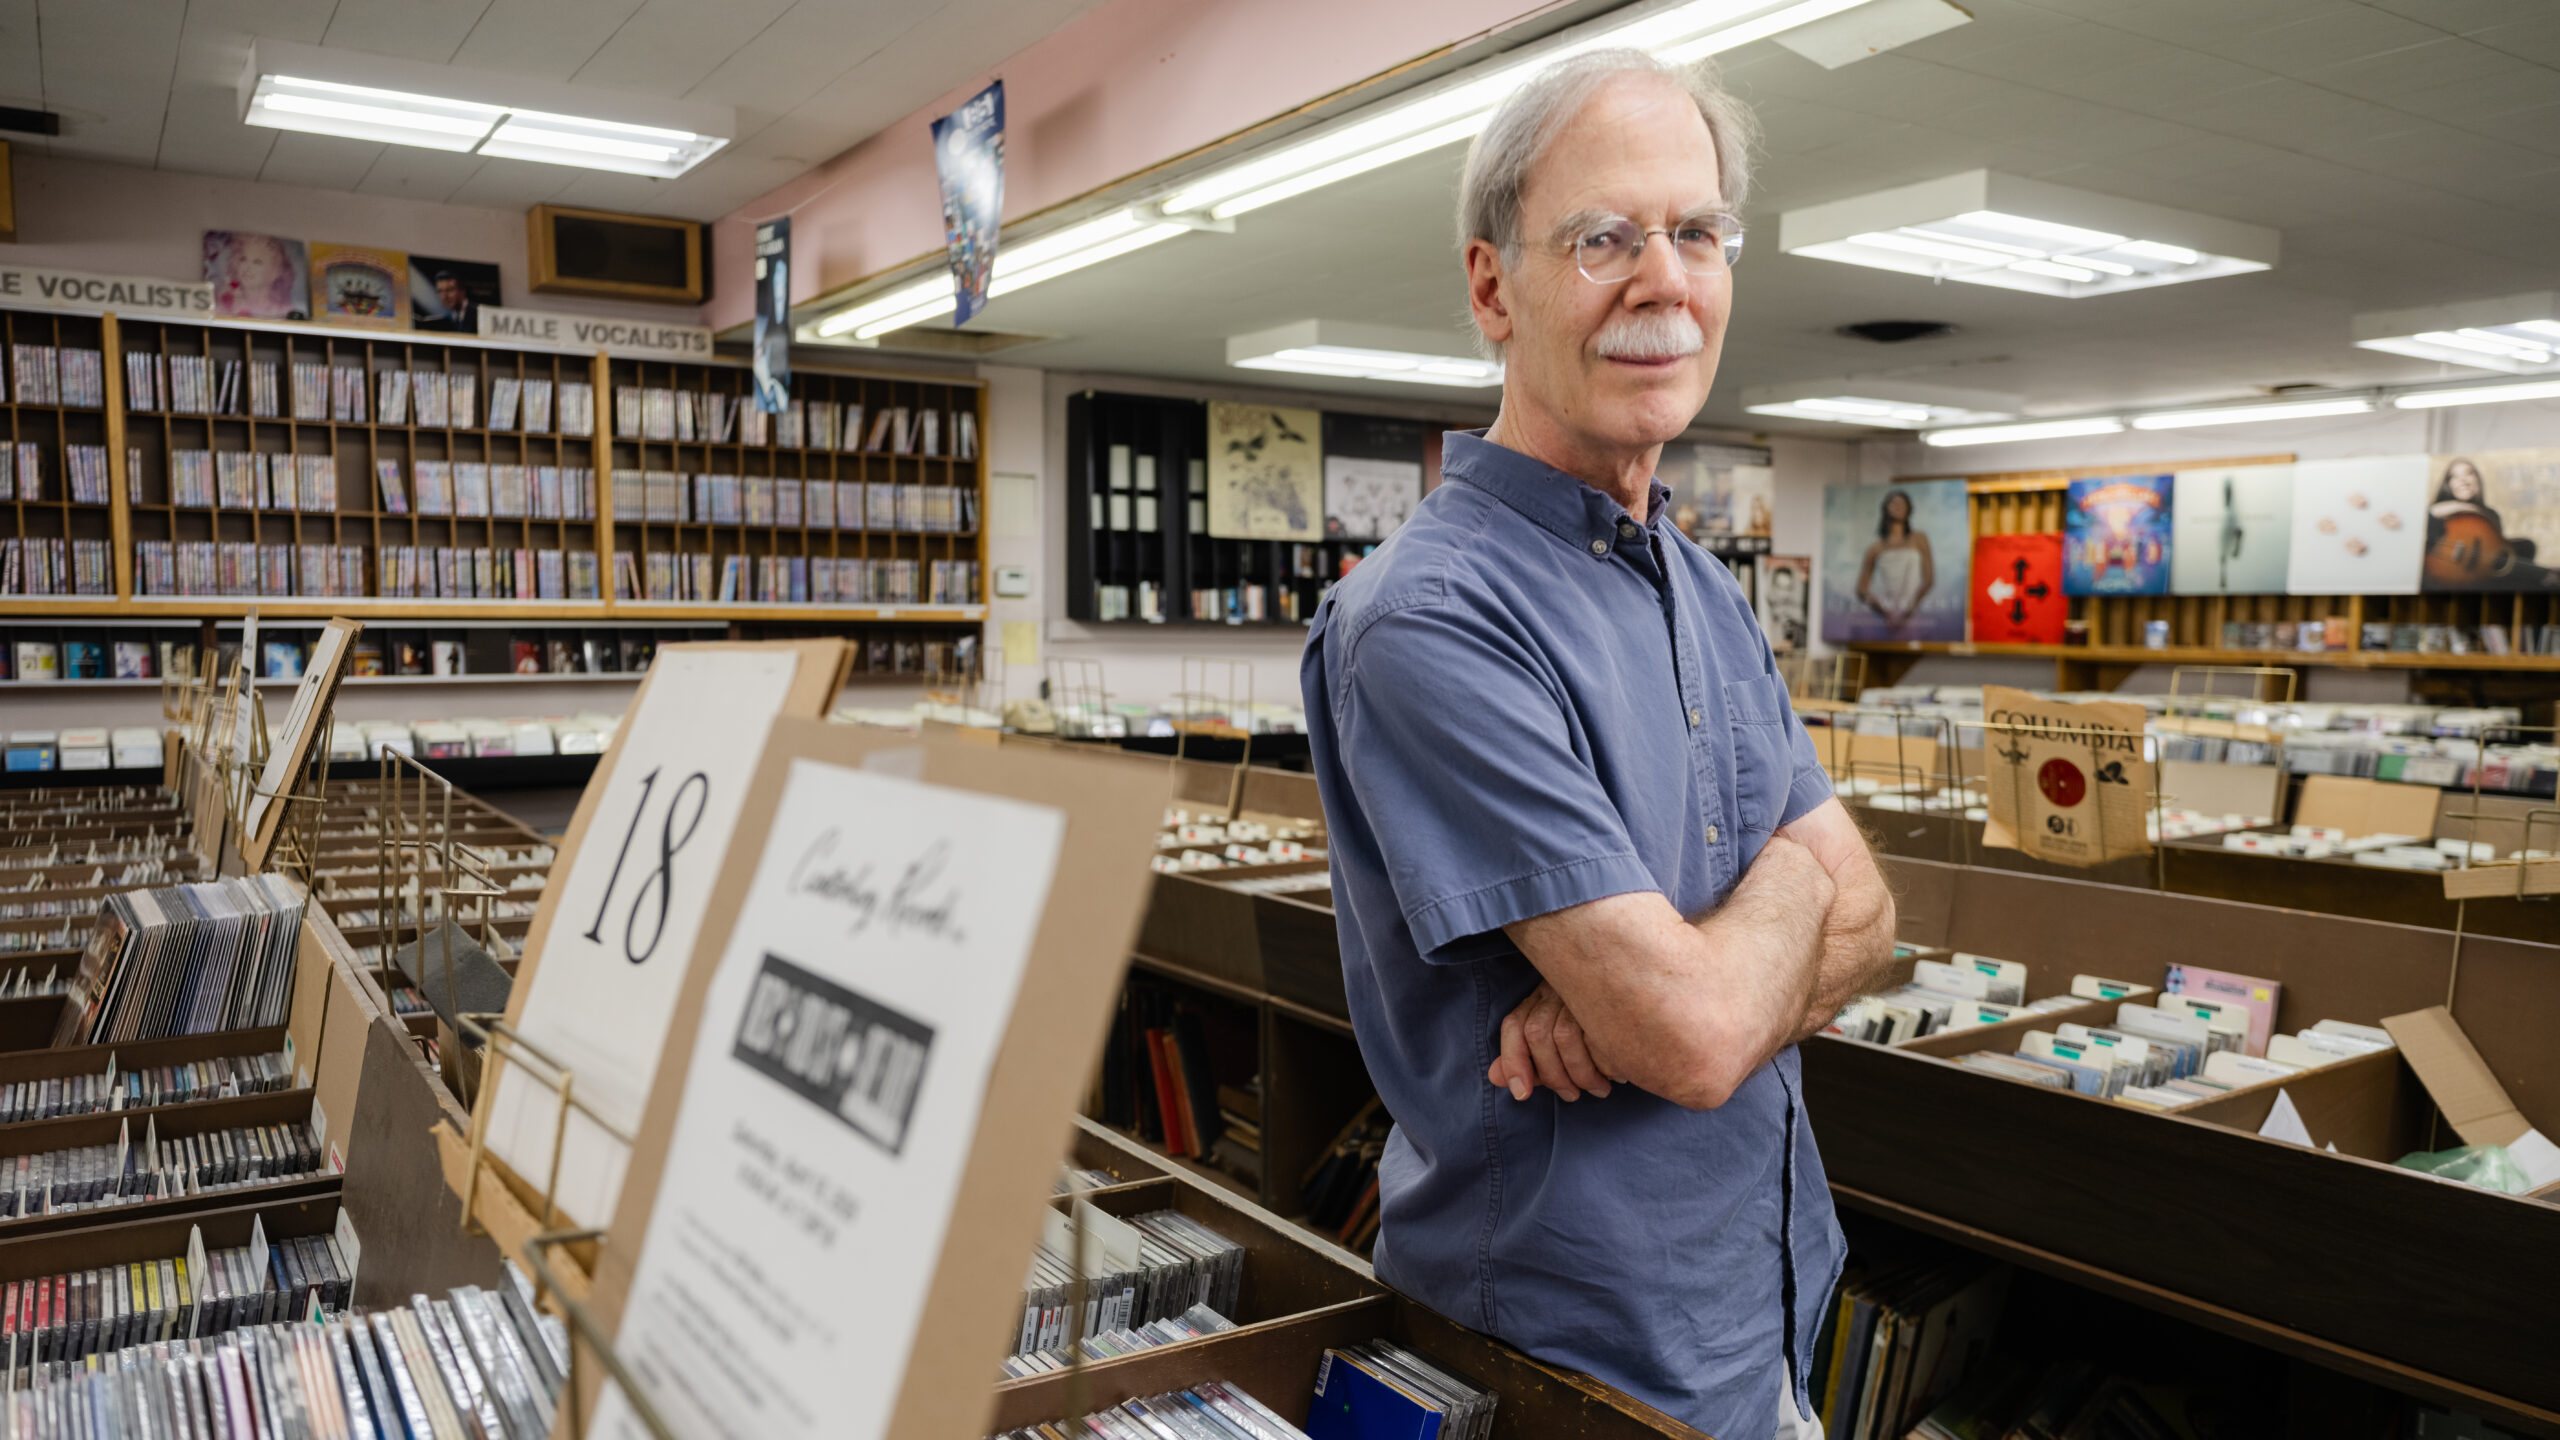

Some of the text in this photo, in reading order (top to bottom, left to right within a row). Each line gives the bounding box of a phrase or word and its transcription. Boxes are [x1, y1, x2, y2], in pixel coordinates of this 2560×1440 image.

[0, 273, 211, 311] E VOCALISTS
[490, 314, 709, 352] MALE VOCALISTS
[1990, 709, 2135, 753] COLUMBIA
[583, 766, 708, 964] 18
